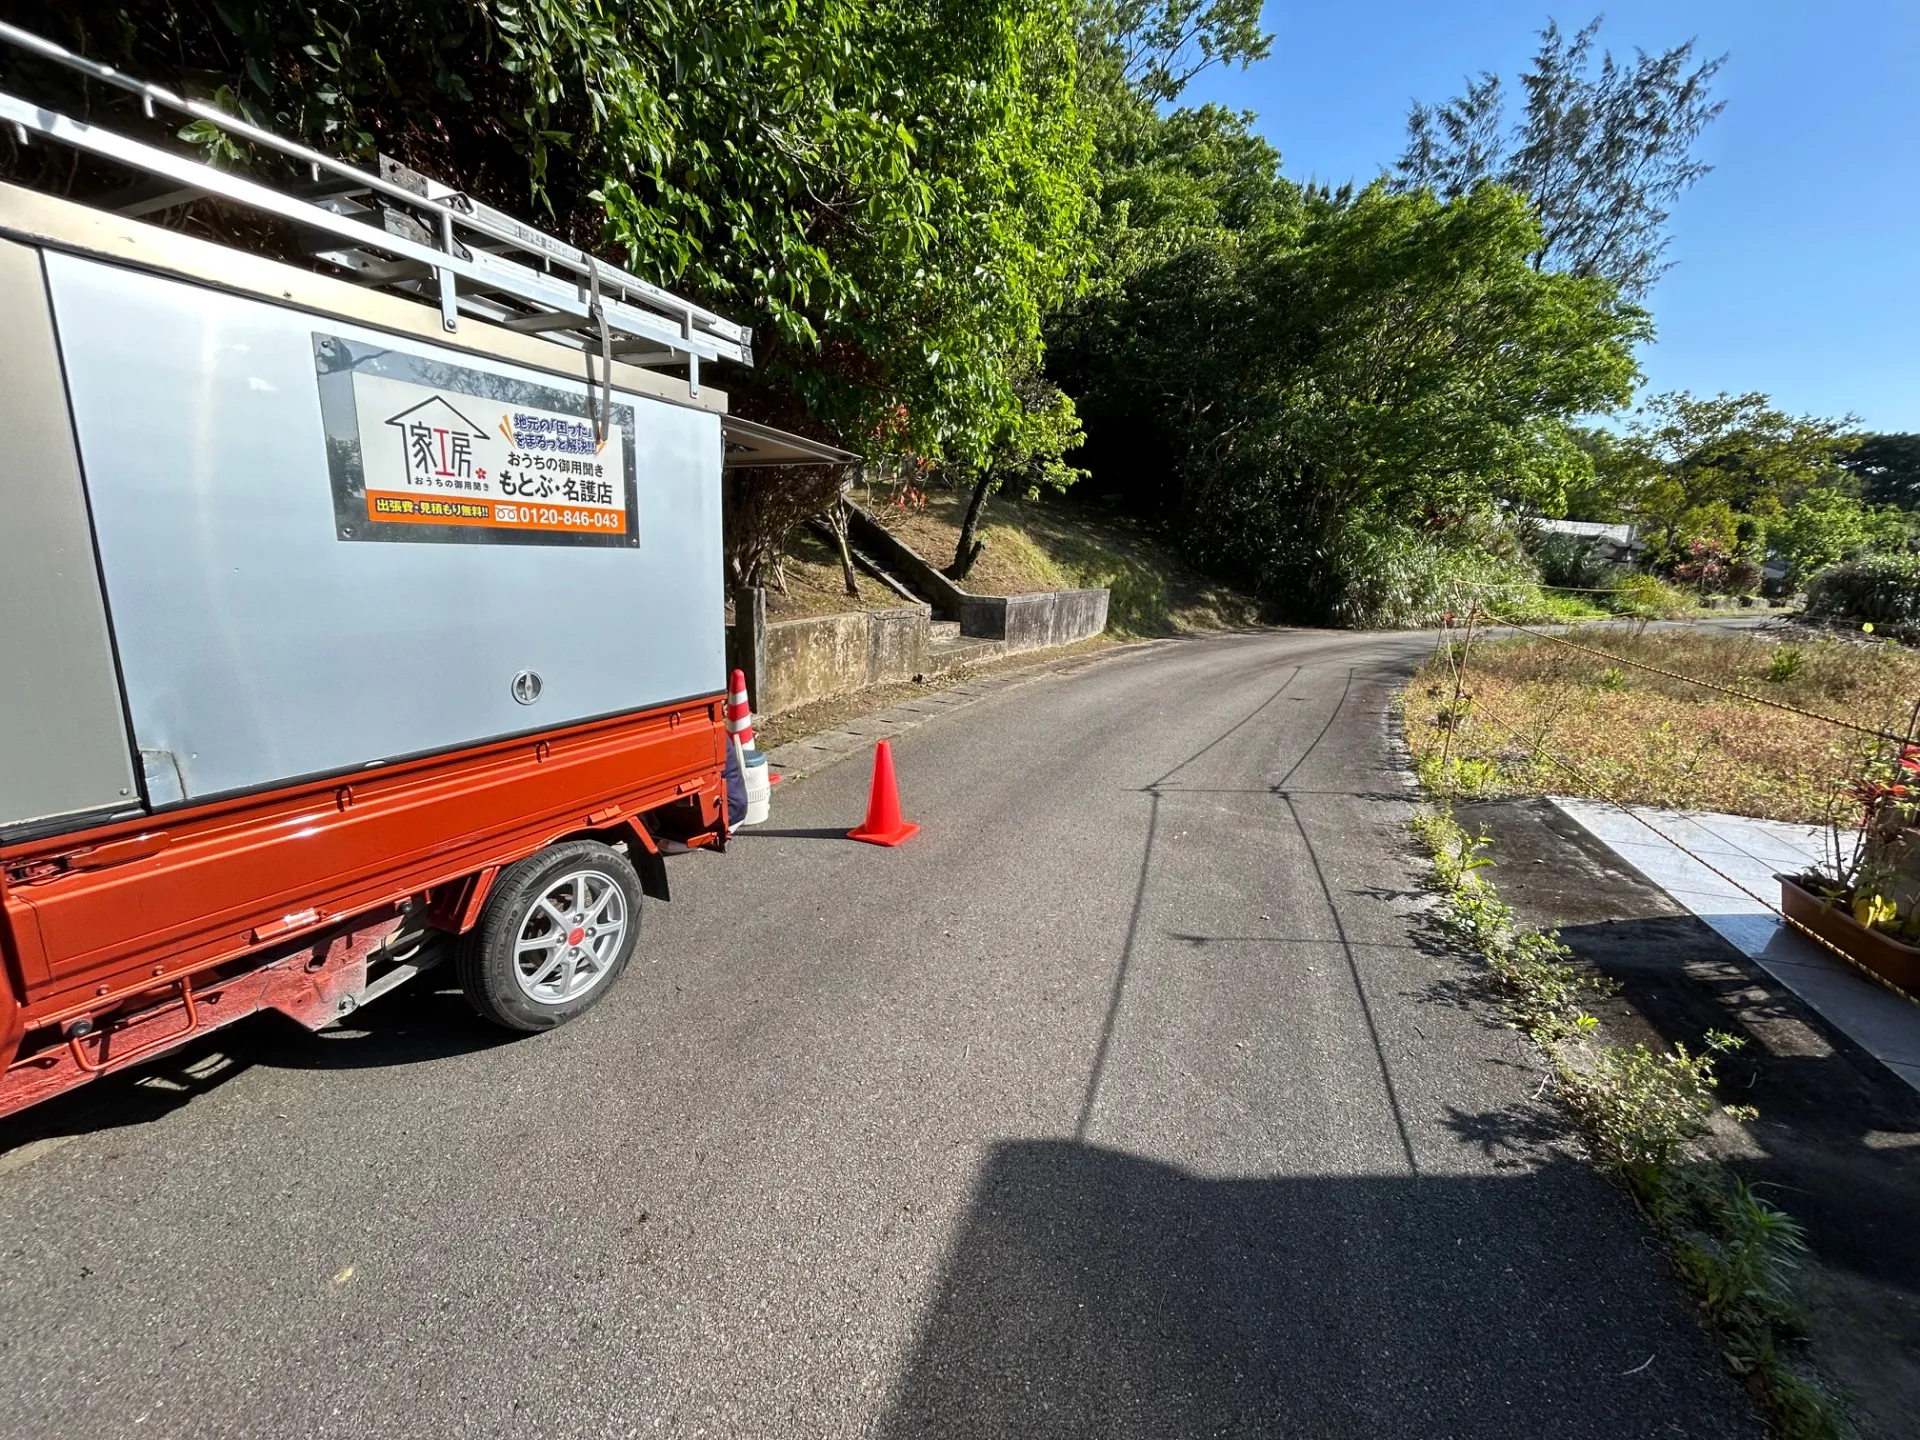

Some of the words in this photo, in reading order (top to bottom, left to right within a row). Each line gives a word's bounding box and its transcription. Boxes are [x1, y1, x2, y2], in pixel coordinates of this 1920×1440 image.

[508, 451, 604, 478] おうちの御用聞き
[414, 476, 489, 492] おうちの御用聞き
[499, 470, 612, 505] もとぶ・名護店
[520, 507, 618, 528] 0120-846-043
